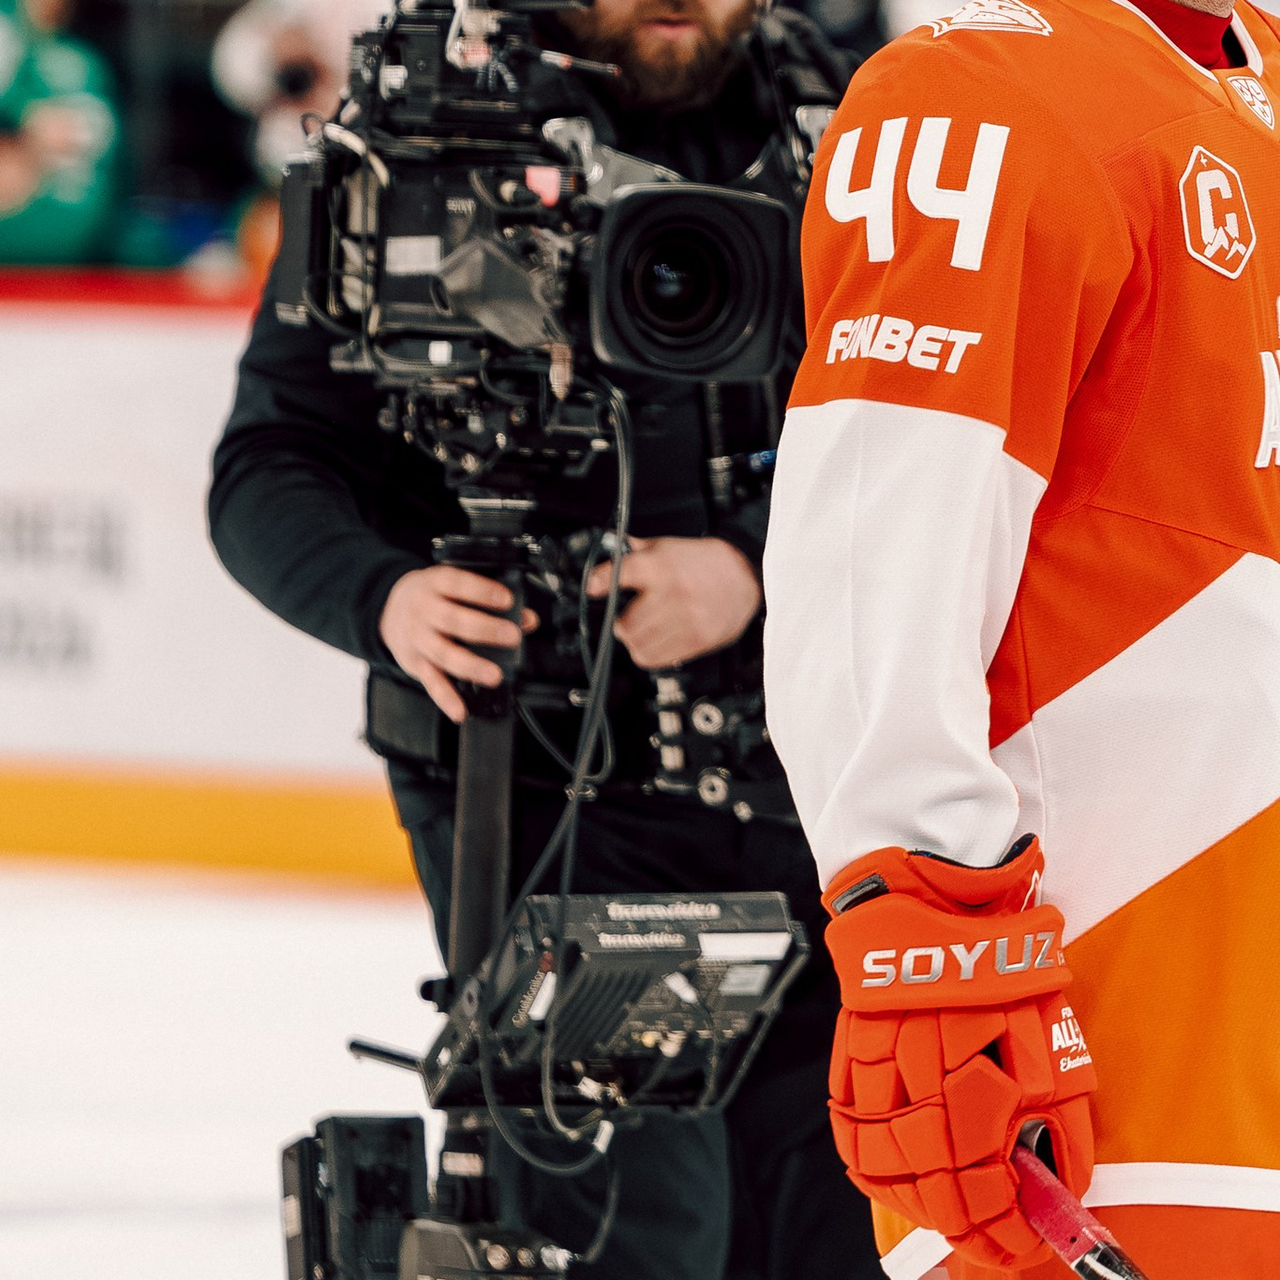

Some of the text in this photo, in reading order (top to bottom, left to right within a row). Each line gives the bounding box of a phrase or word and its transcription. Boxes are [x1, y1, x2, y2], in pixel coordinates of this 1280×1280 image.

[825, 116, 1010, 271] 44
[825, 314, 983, 374] FONBET
[861, 931, 1056, 988] SOYUZ
